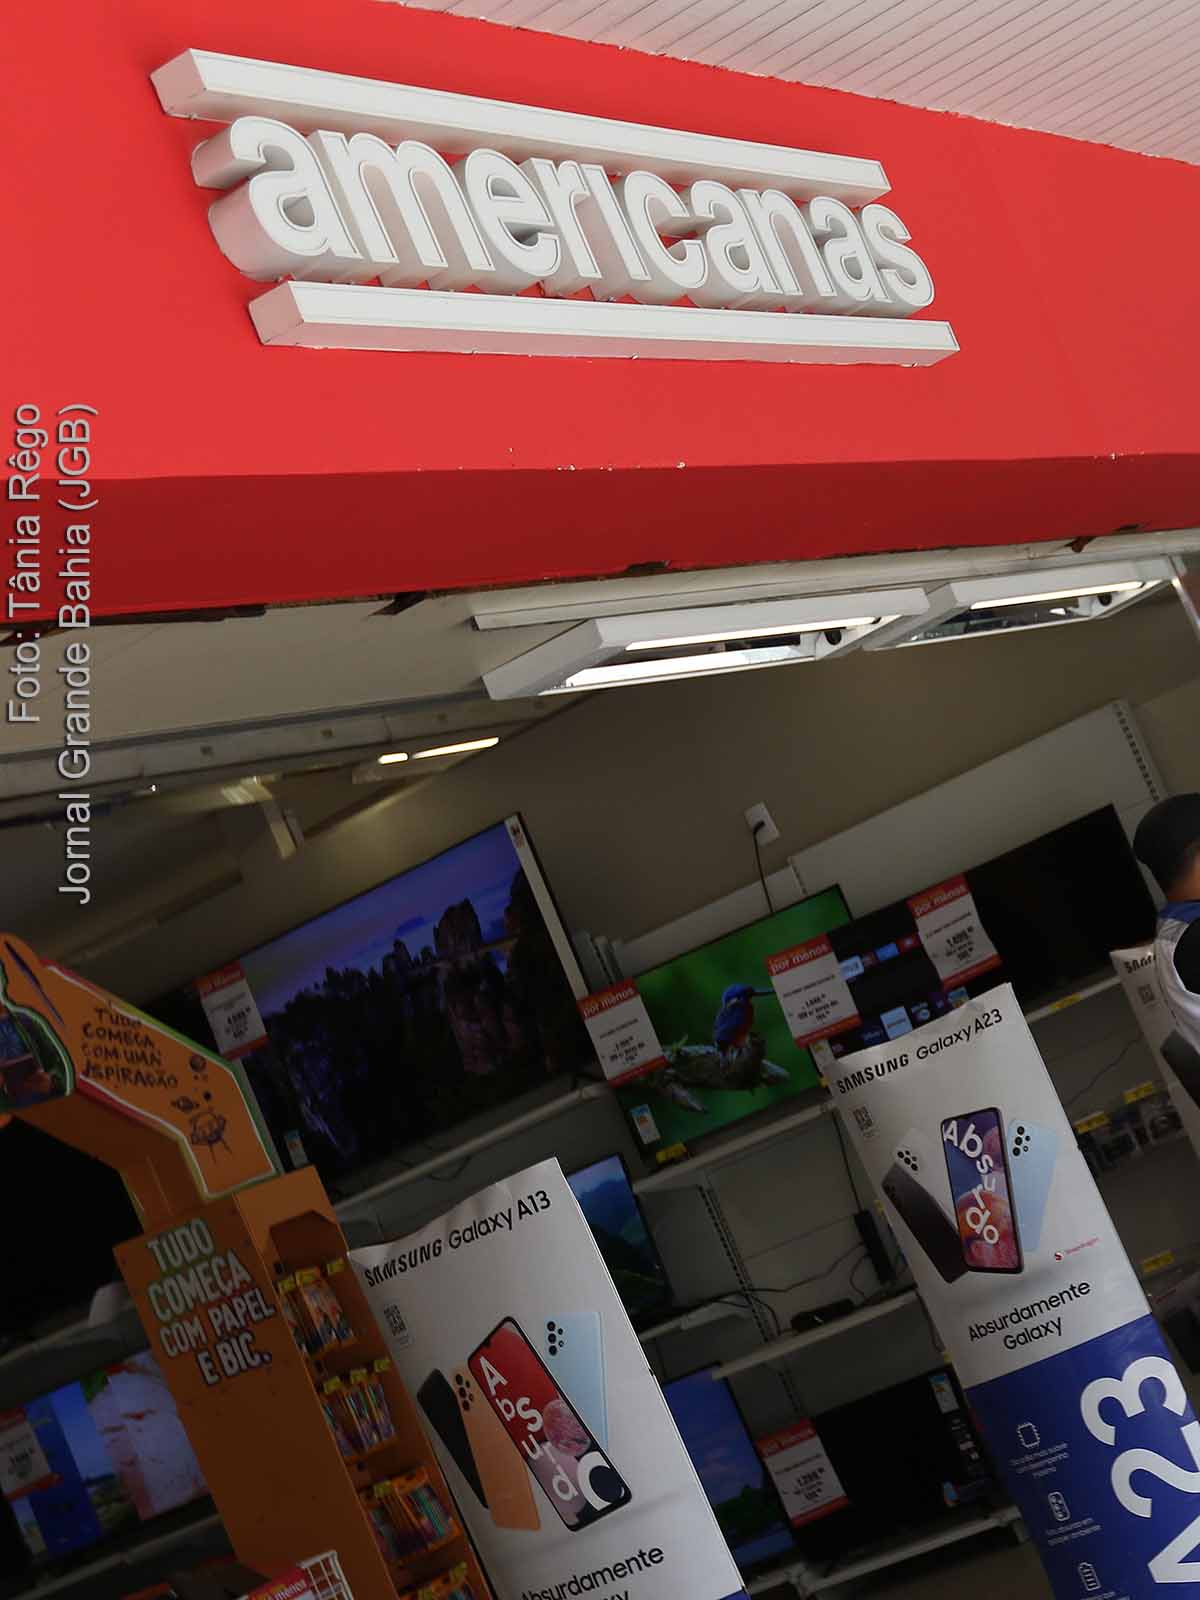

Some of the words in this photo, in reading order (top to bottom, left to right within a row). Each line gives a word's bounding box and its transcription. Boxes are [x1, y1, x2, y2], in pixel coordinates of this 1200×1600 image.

[203, 116, 936, 317] americanas
[837, 1053, 910, 1095] SAMSUNG
[916, 1025, 973, 1060] Galaxy
[974, 1008, 1003, 1034] A23
[147, 1217, 215, 1272] TUDO
[363, 1239, 442, 1287] SAMSUNG
[448, 1208, 513, 1249] Galaxy
[517, 1190, 551, 1221] A13
[159, 1315, 208, 1357] COM
[208, 1287, 276, 1337] PAPEL
[968, 1281, 1092, 1342] Absurdamente
[1003, 1317, 1063, 1351] Galaxy
[197, 1350, 220, 1385] E
